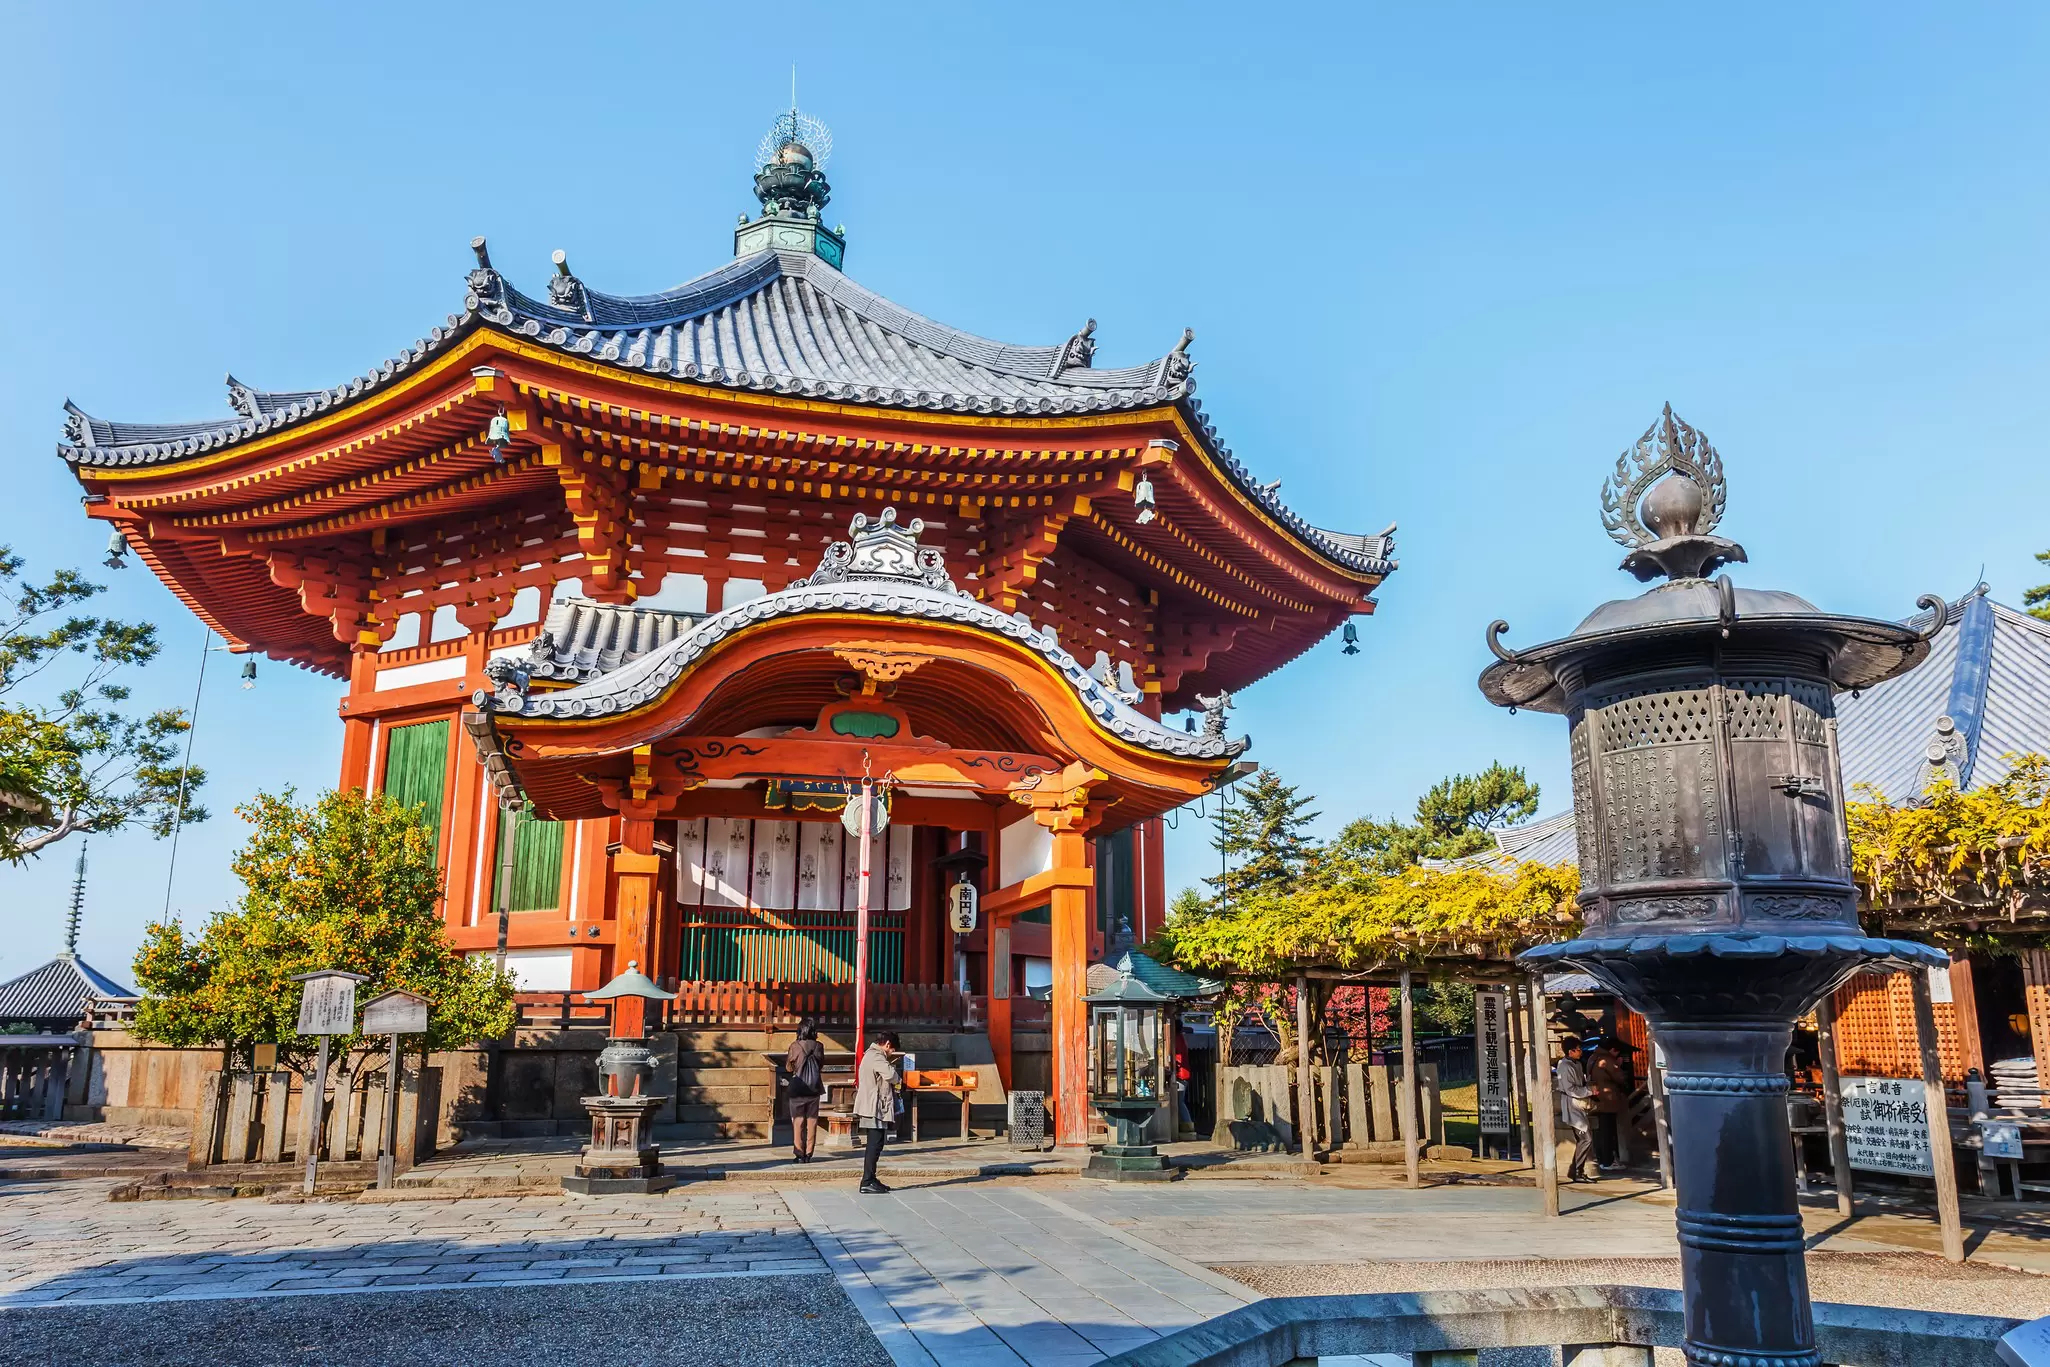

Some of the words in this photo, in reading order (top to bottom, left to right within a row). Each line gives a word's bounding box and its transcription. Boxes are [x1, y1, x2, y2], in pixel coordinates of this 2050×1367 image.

[959, 887, 972, 929] 南円堂
[1856, 1081, 1902, 1095] 一言観音
